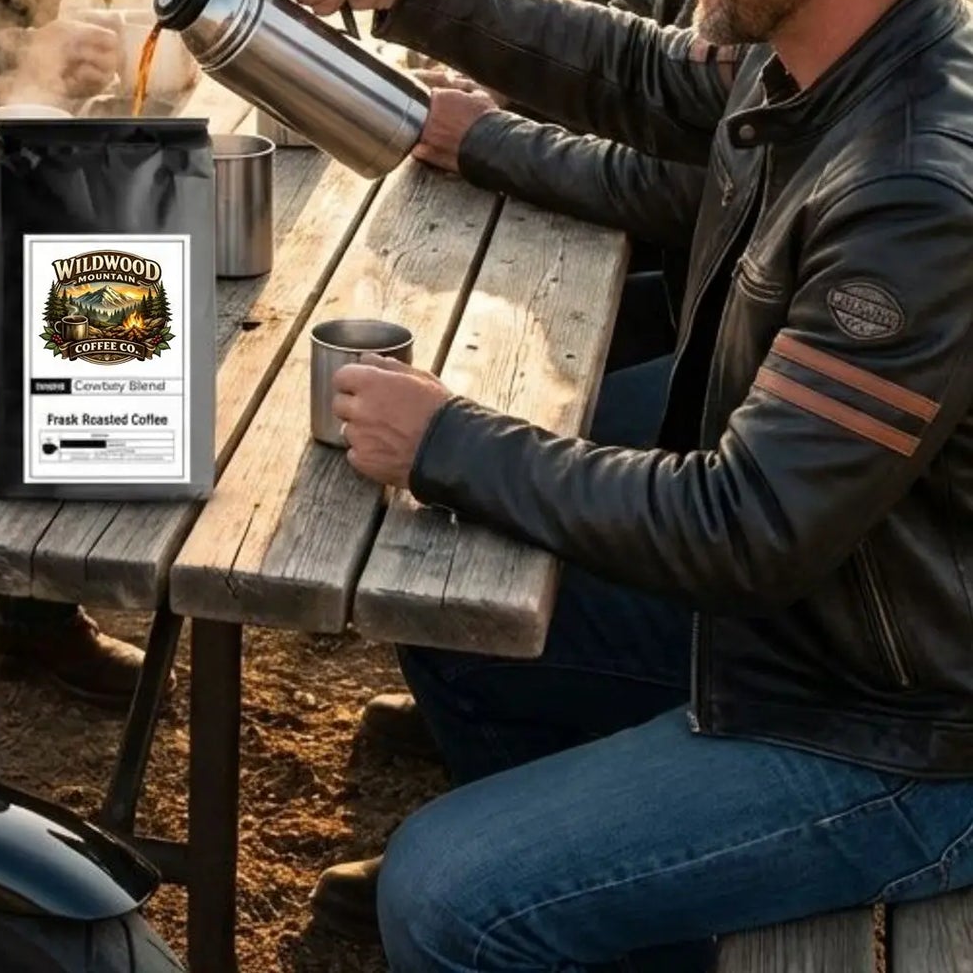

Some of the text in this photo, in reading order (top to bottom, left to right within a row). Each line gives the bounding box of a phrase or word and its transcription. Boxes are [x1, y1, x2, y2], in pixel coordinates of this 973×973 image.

[54, 255, 161, 281] WILDWOOD
[78, 273, 136, 284] MOUNTAIN
[75, 341, 140, 355] COFFEE CO.
